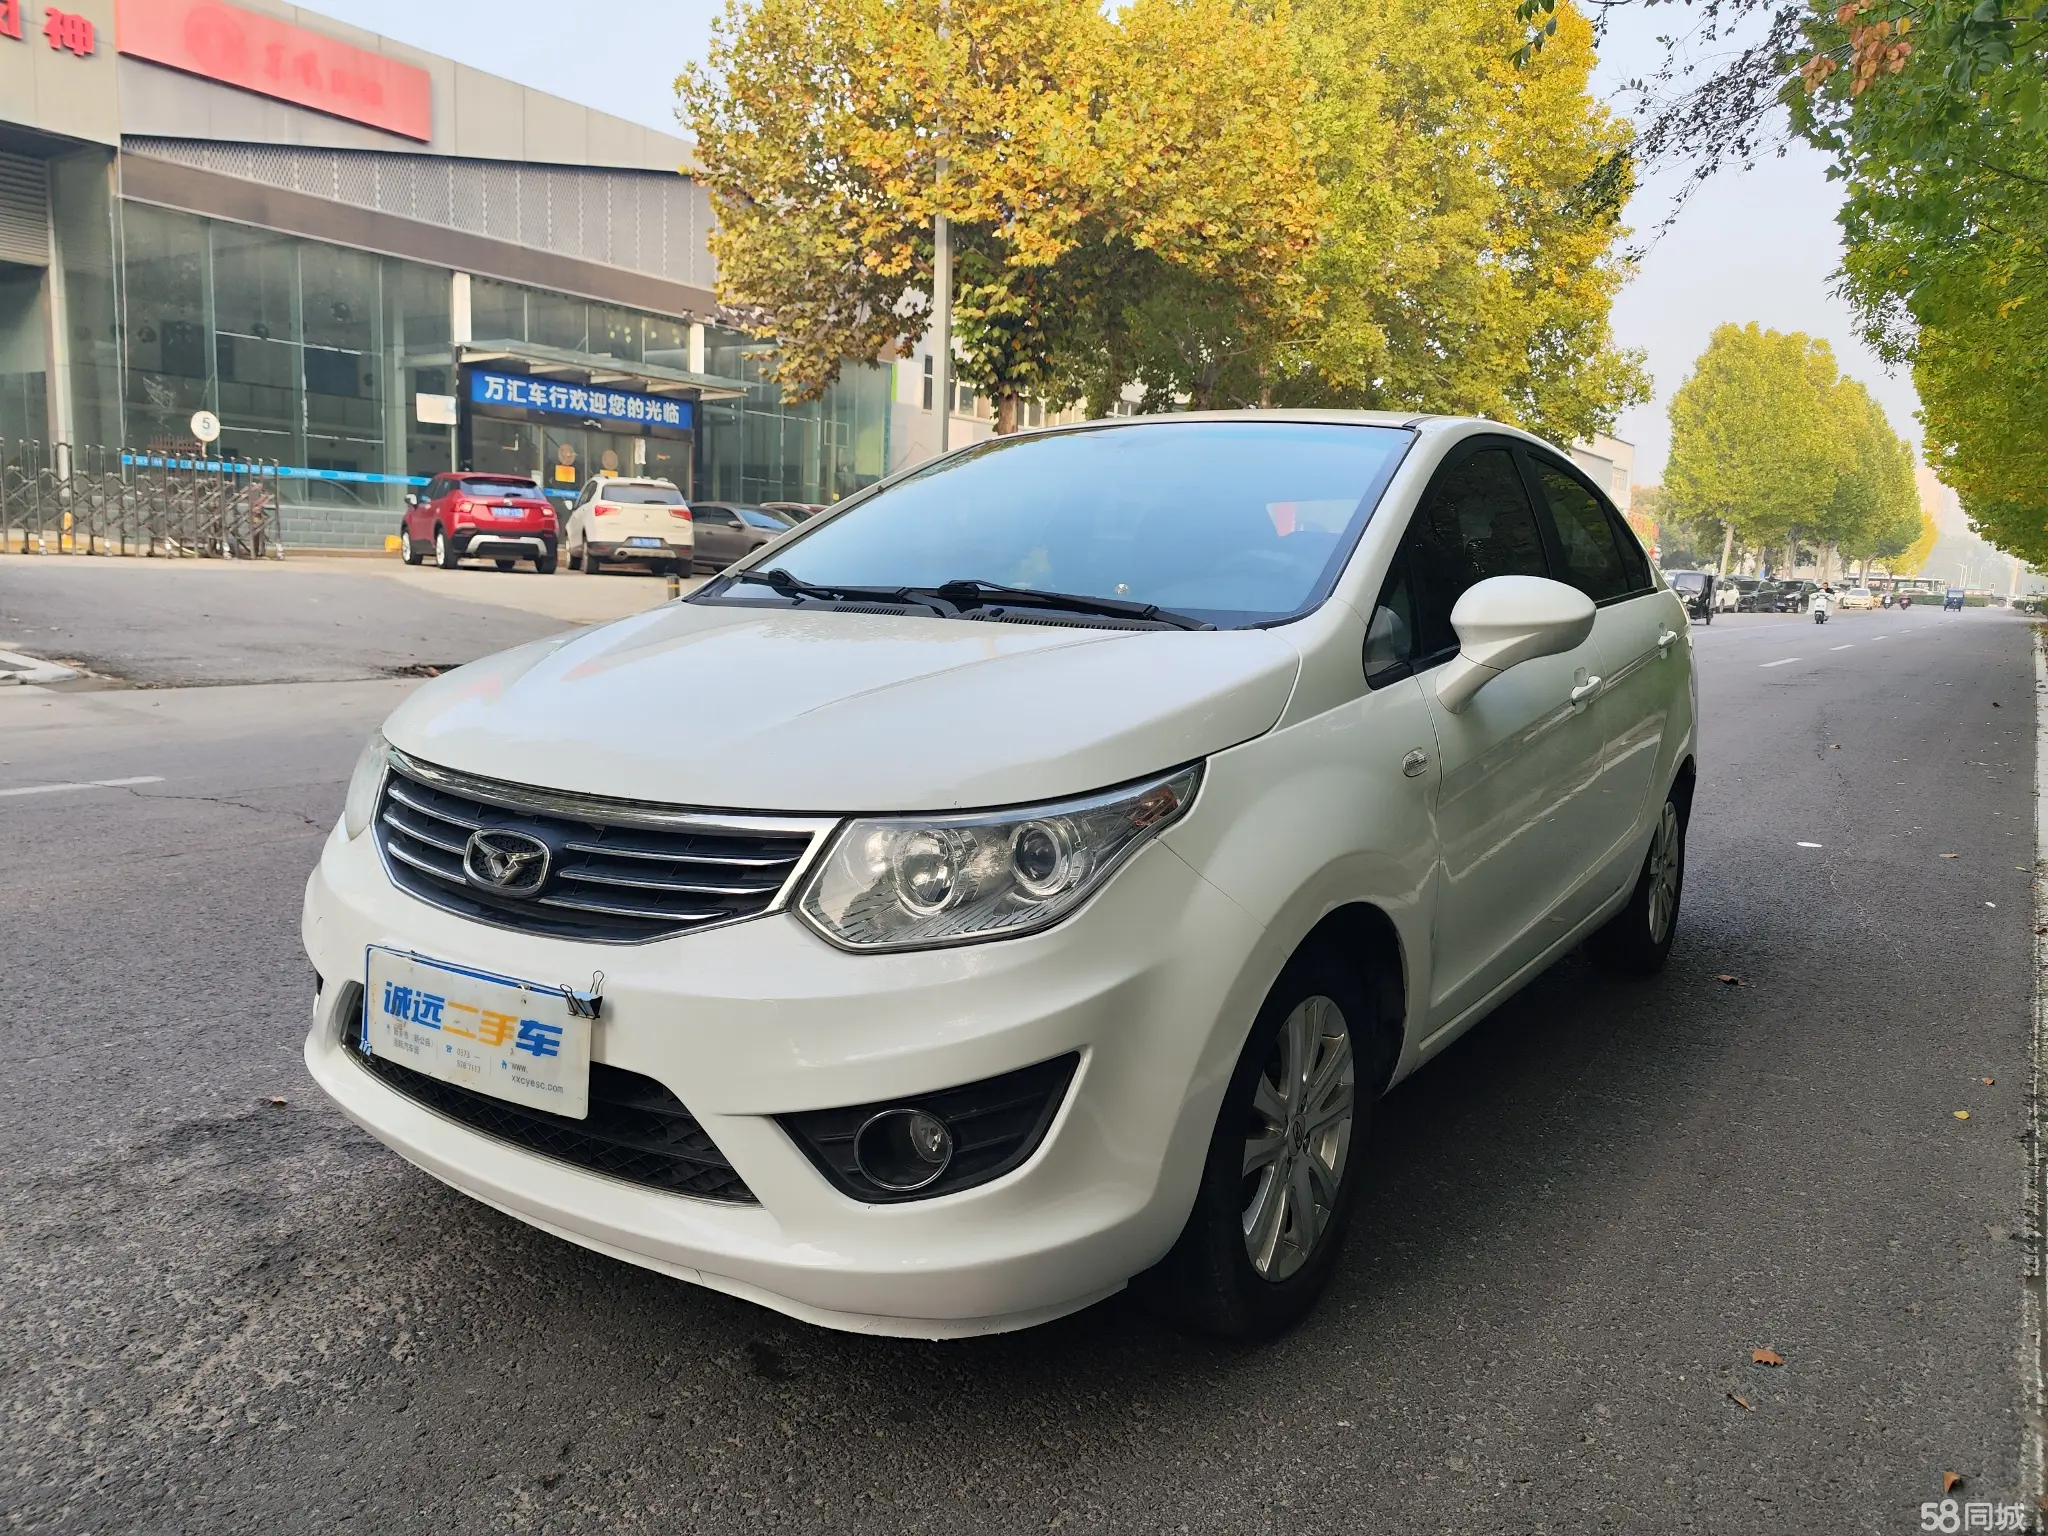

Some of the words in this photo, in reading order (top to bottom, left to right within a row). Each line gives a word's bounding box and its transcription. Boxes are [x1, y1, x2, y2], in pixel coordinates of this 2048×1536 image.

[484, 375, 680, 425] 万汇车行欢迎您的光临
[202, 417, 211, 430] 5
[384, 981, 563, 1057] 诚远二手车
[456, 1047, 471, 1059] 0373
[511, 1074, 564, 1094] xxcyesc.com
